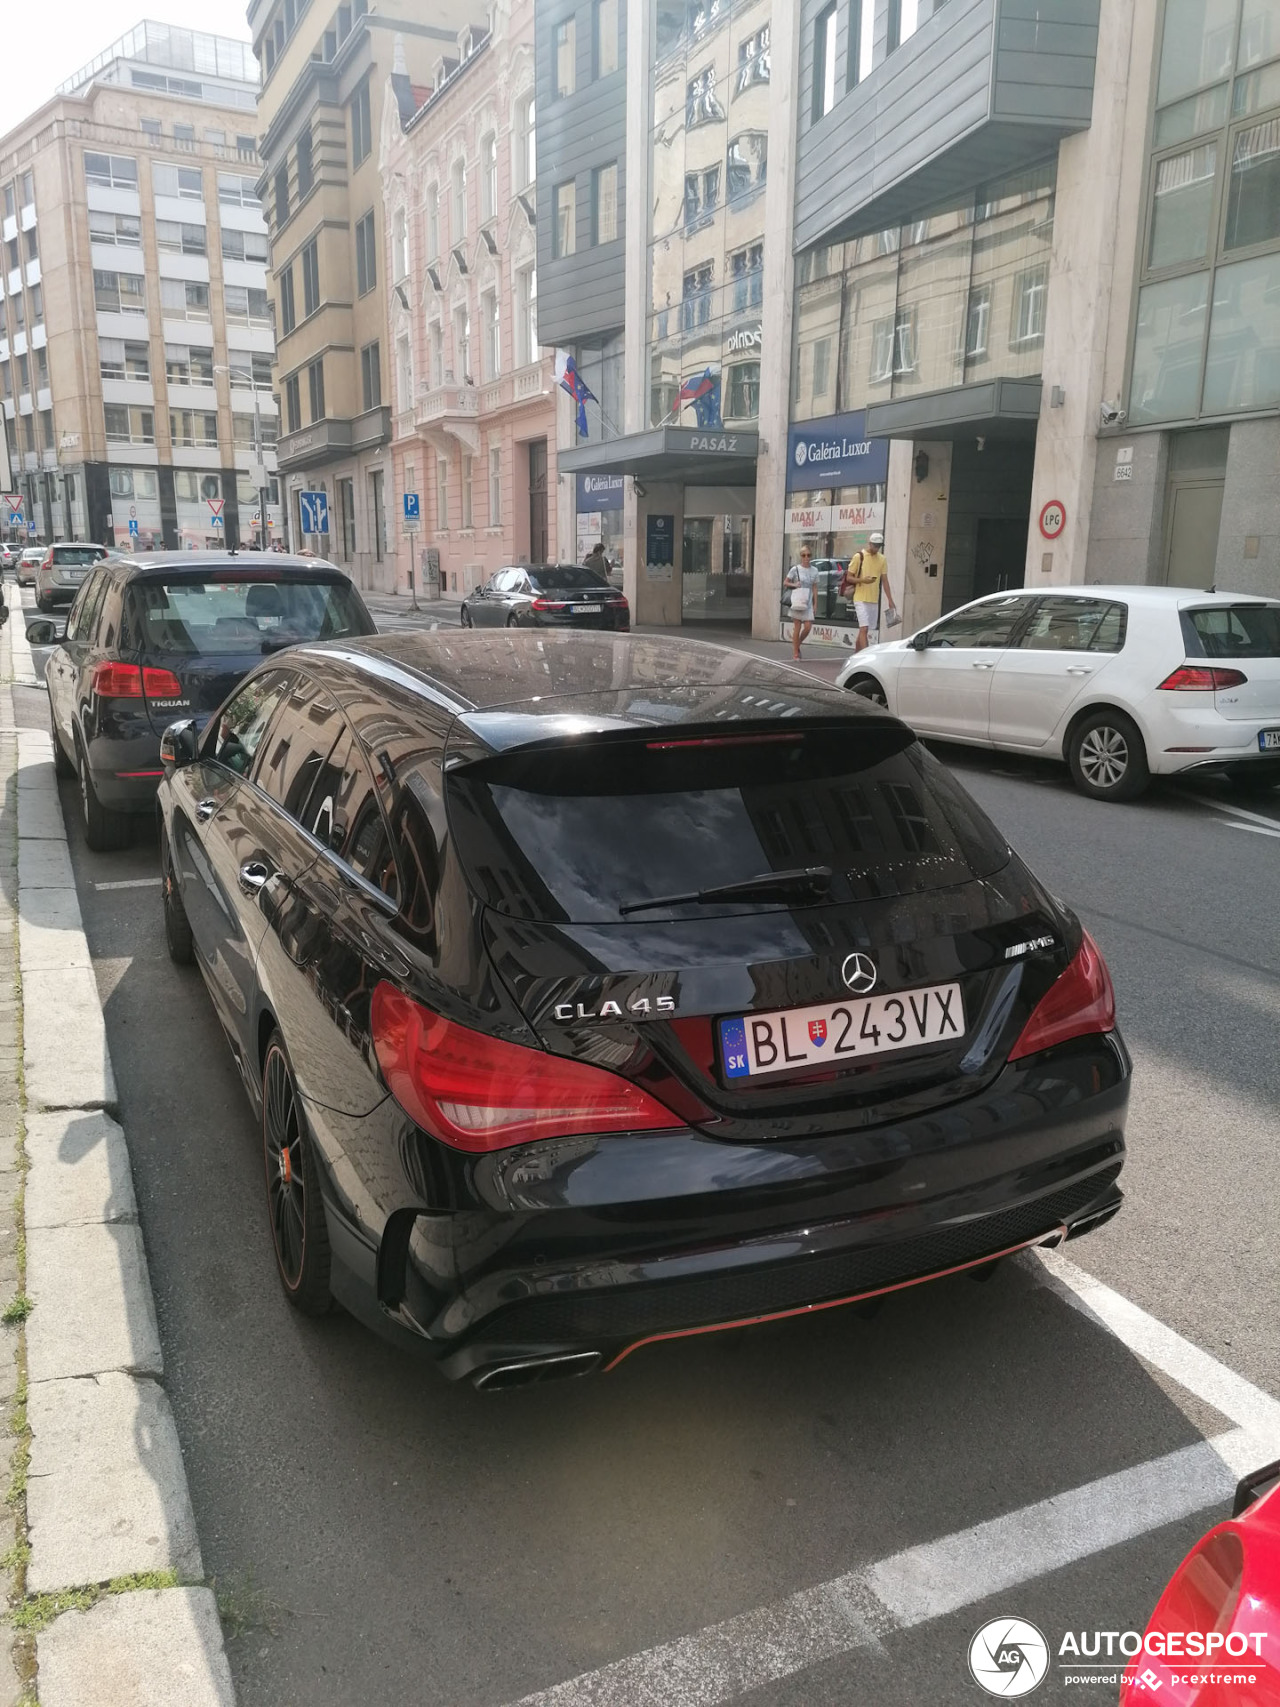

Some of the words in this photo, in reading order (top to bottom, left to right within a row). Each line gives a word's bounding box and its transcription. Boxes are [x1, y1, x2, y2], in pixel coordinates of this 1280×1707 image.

[690, 434, 738, 451] PASÁŽ
[808, 441, 841, 462] Galéria
[842, 438, 872, 458] Luxor
[1116, 466, 1132, 479] 6642
[407, 495, 416, 511] P
[791, 511, 815, 523] MAXI
[839, 507, 865, 520] MAXI
[1044, 514, 1060, 526] LPG
[812, 626, 833, 636] MAXI
[555, 1000, 622, 1019] CLA
[631, 996, 675, 1013] 45
[751, 1017, 808, 1068] BL
[831, 989, 958, 1054] 243VX
[728, 1055, 745, 1069] SK
